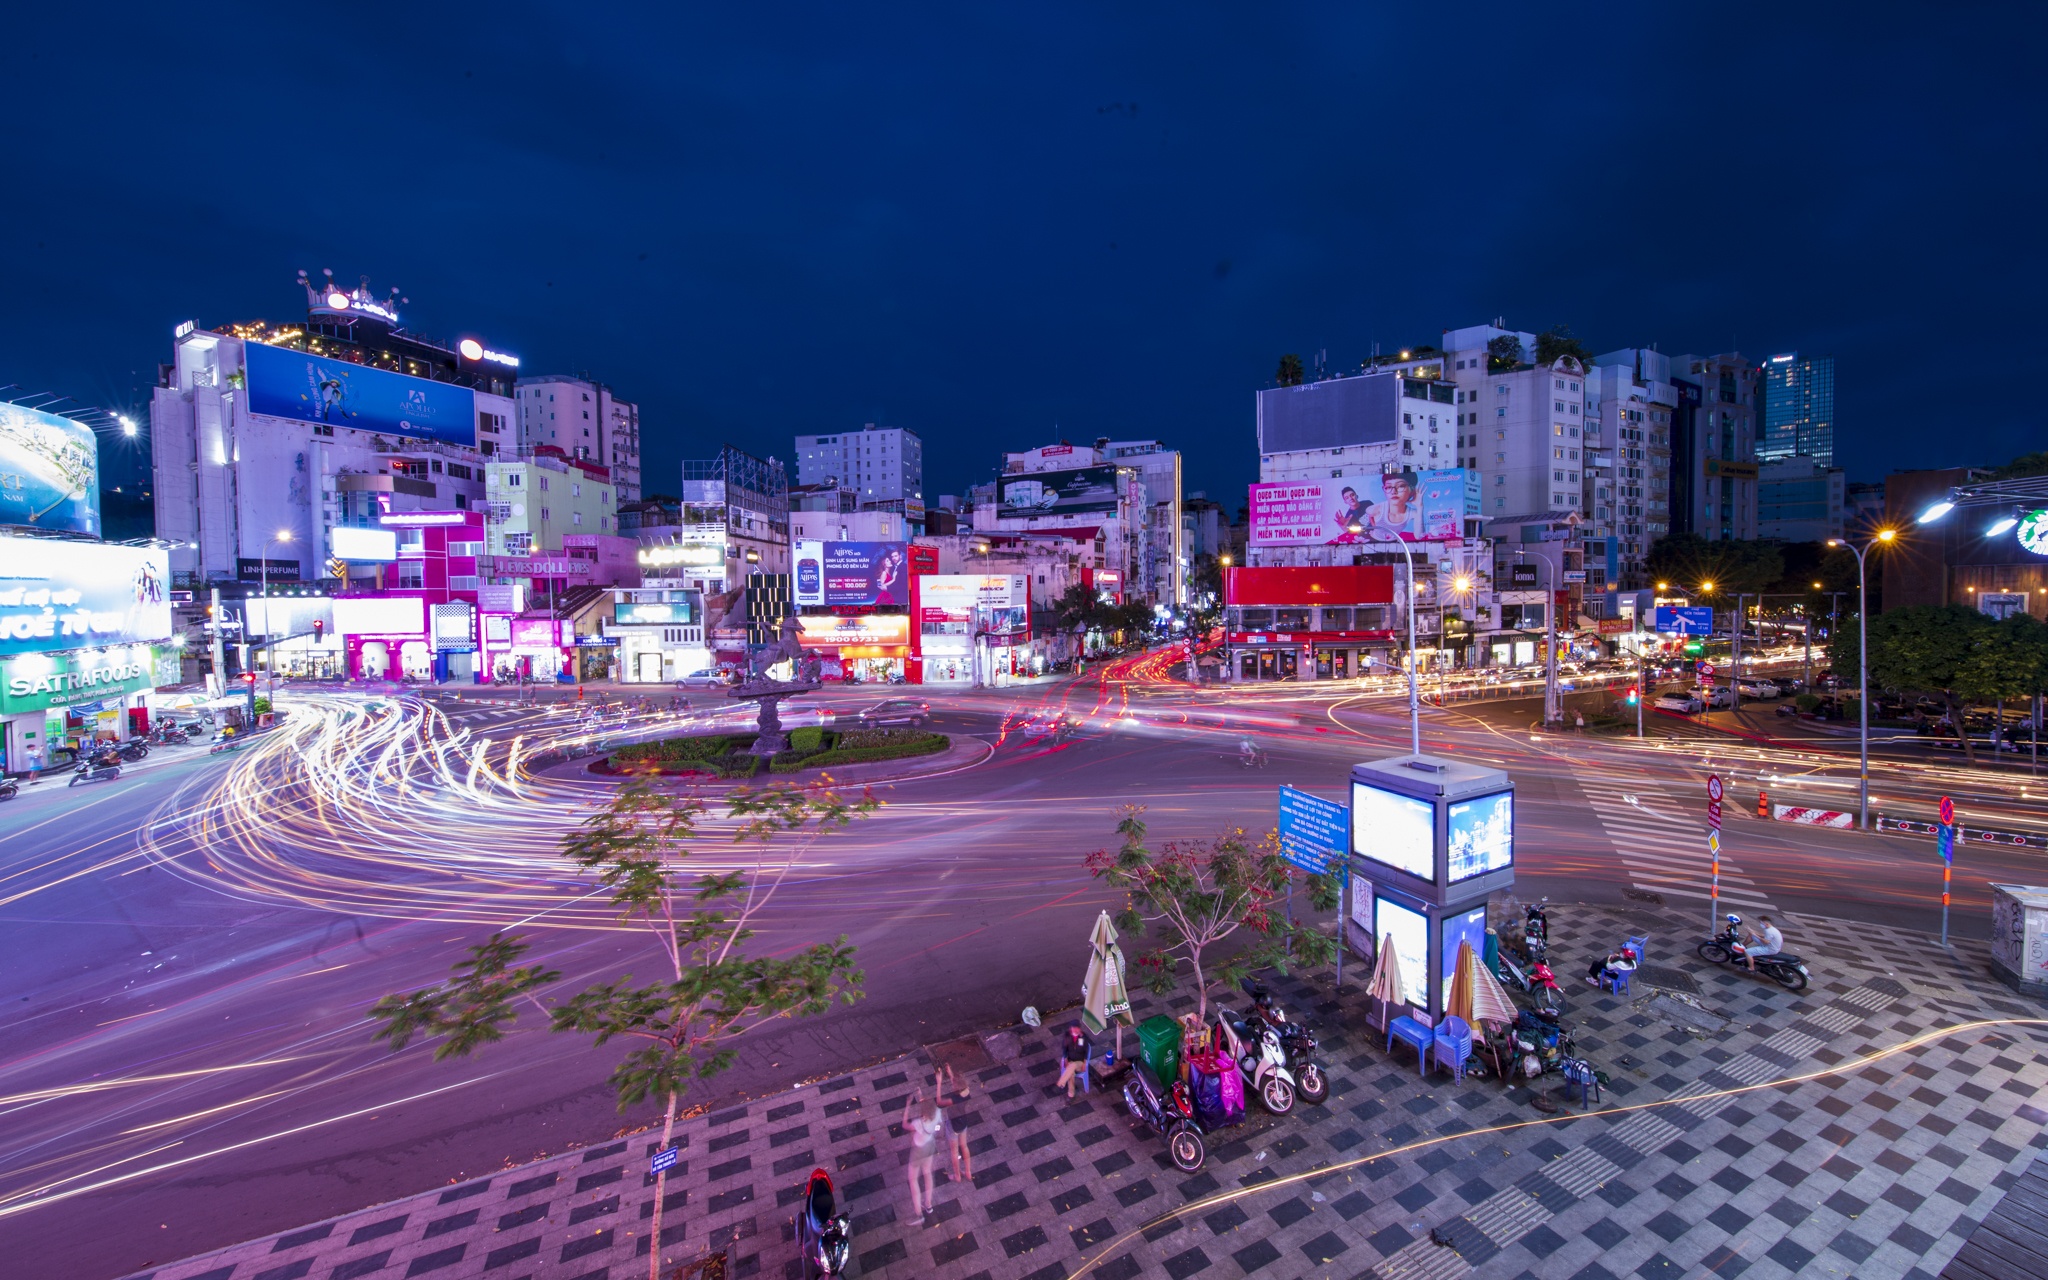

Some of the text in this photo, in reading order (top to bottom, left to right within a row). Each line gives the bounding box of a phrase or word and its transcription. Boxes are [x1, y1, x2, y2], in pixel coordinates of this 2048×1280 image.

[3, 493, 24, 502] NAM
[533, 562, 590, 574] DOLL EYES
[1515, 570, 1535, 581] ioma
[9, 663, 141, 697] SATRAFOODS
[50, 694, 67, 704] CỬA
